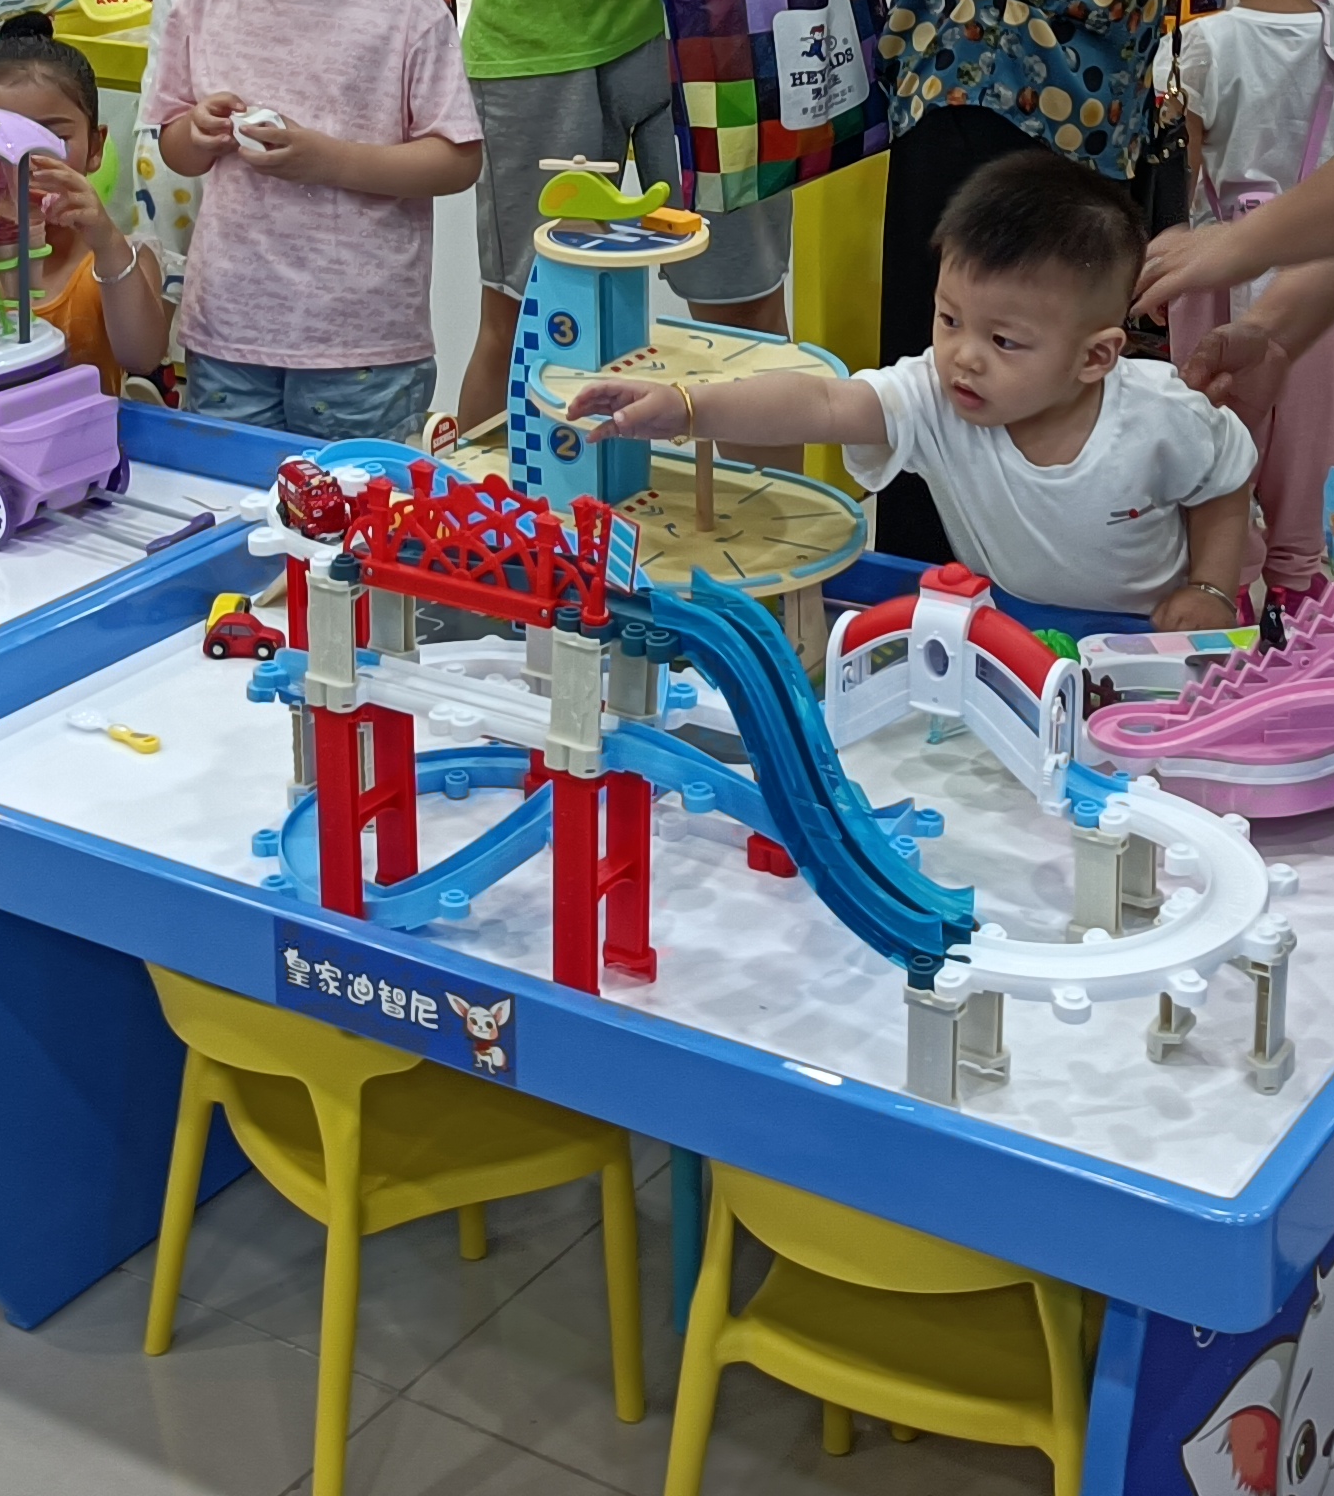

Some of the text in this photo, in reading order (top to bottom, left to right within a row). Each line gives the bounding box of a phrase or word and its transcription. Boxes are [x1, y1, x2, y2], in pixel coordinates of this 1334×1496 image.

[553, 315, 572, 344] 3
[555, 429, 576, 457] 2
[283, 947, 439, 1030] 皇家迪智尼
